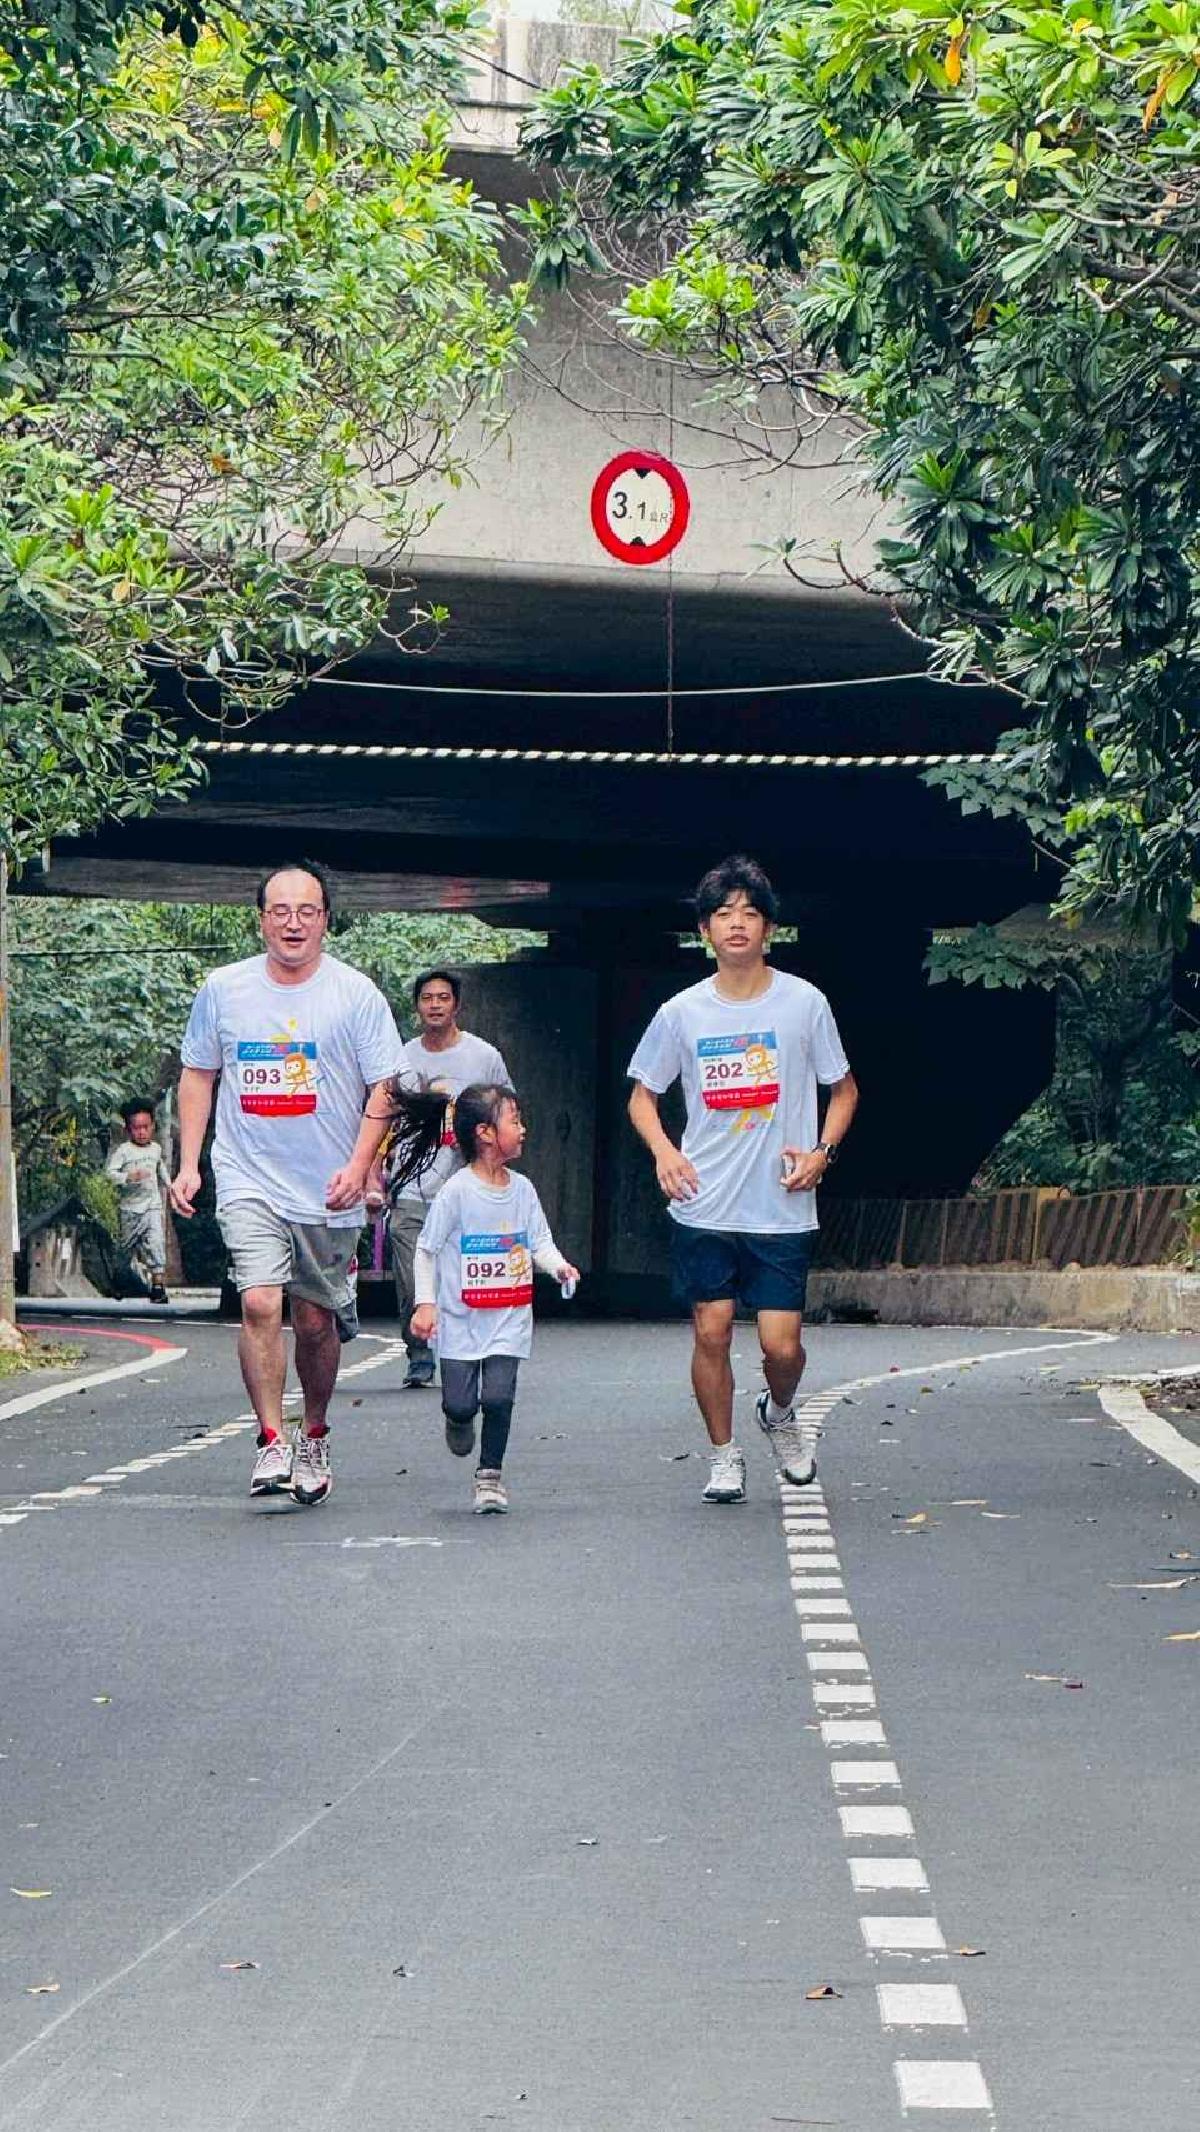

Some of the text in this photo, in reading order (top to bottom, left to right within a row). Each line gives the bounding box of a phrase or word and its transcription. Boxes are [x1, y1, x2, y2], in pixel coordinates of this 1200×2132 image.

[612, 491, 646, 520] 3.1
[243, 1068, 281, 1085] 093
[705, 1062, 743, 1080] 202
[467, 1262, 506, 1279] 092
